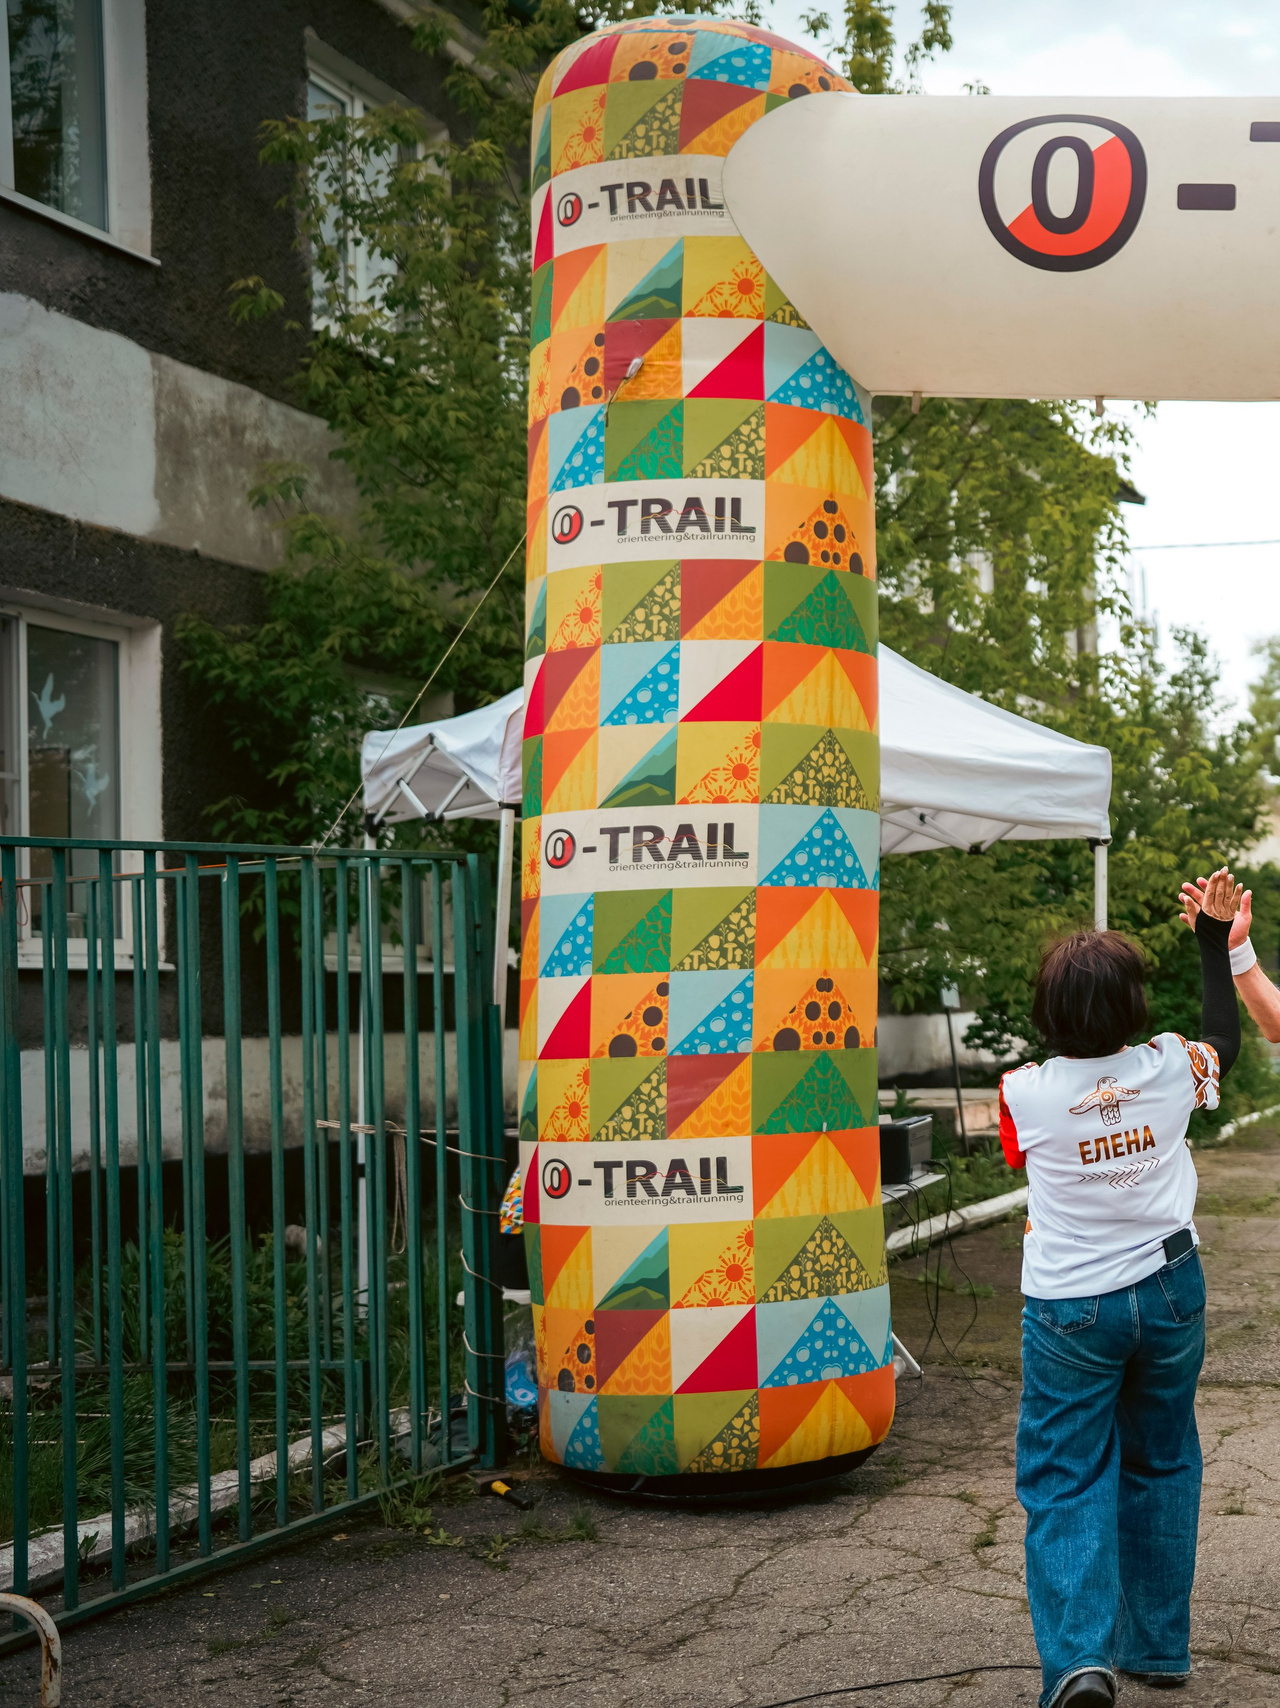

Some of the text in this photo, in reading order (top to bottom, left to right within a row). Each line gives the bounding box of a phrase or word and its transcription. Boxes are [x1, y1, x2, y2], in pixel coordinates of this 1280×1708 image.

[610, 208, 725, 222] orienteering&trailrunning
[617, 532, 756, 544] orienteering&trailrunning
[609, 859, 749, 872] orienteering&trailrunning
[1078, 1125, 1156, 1165] ЕЛЕНА
[605, 1194, 744, 1206] orienteering&trailrunning
